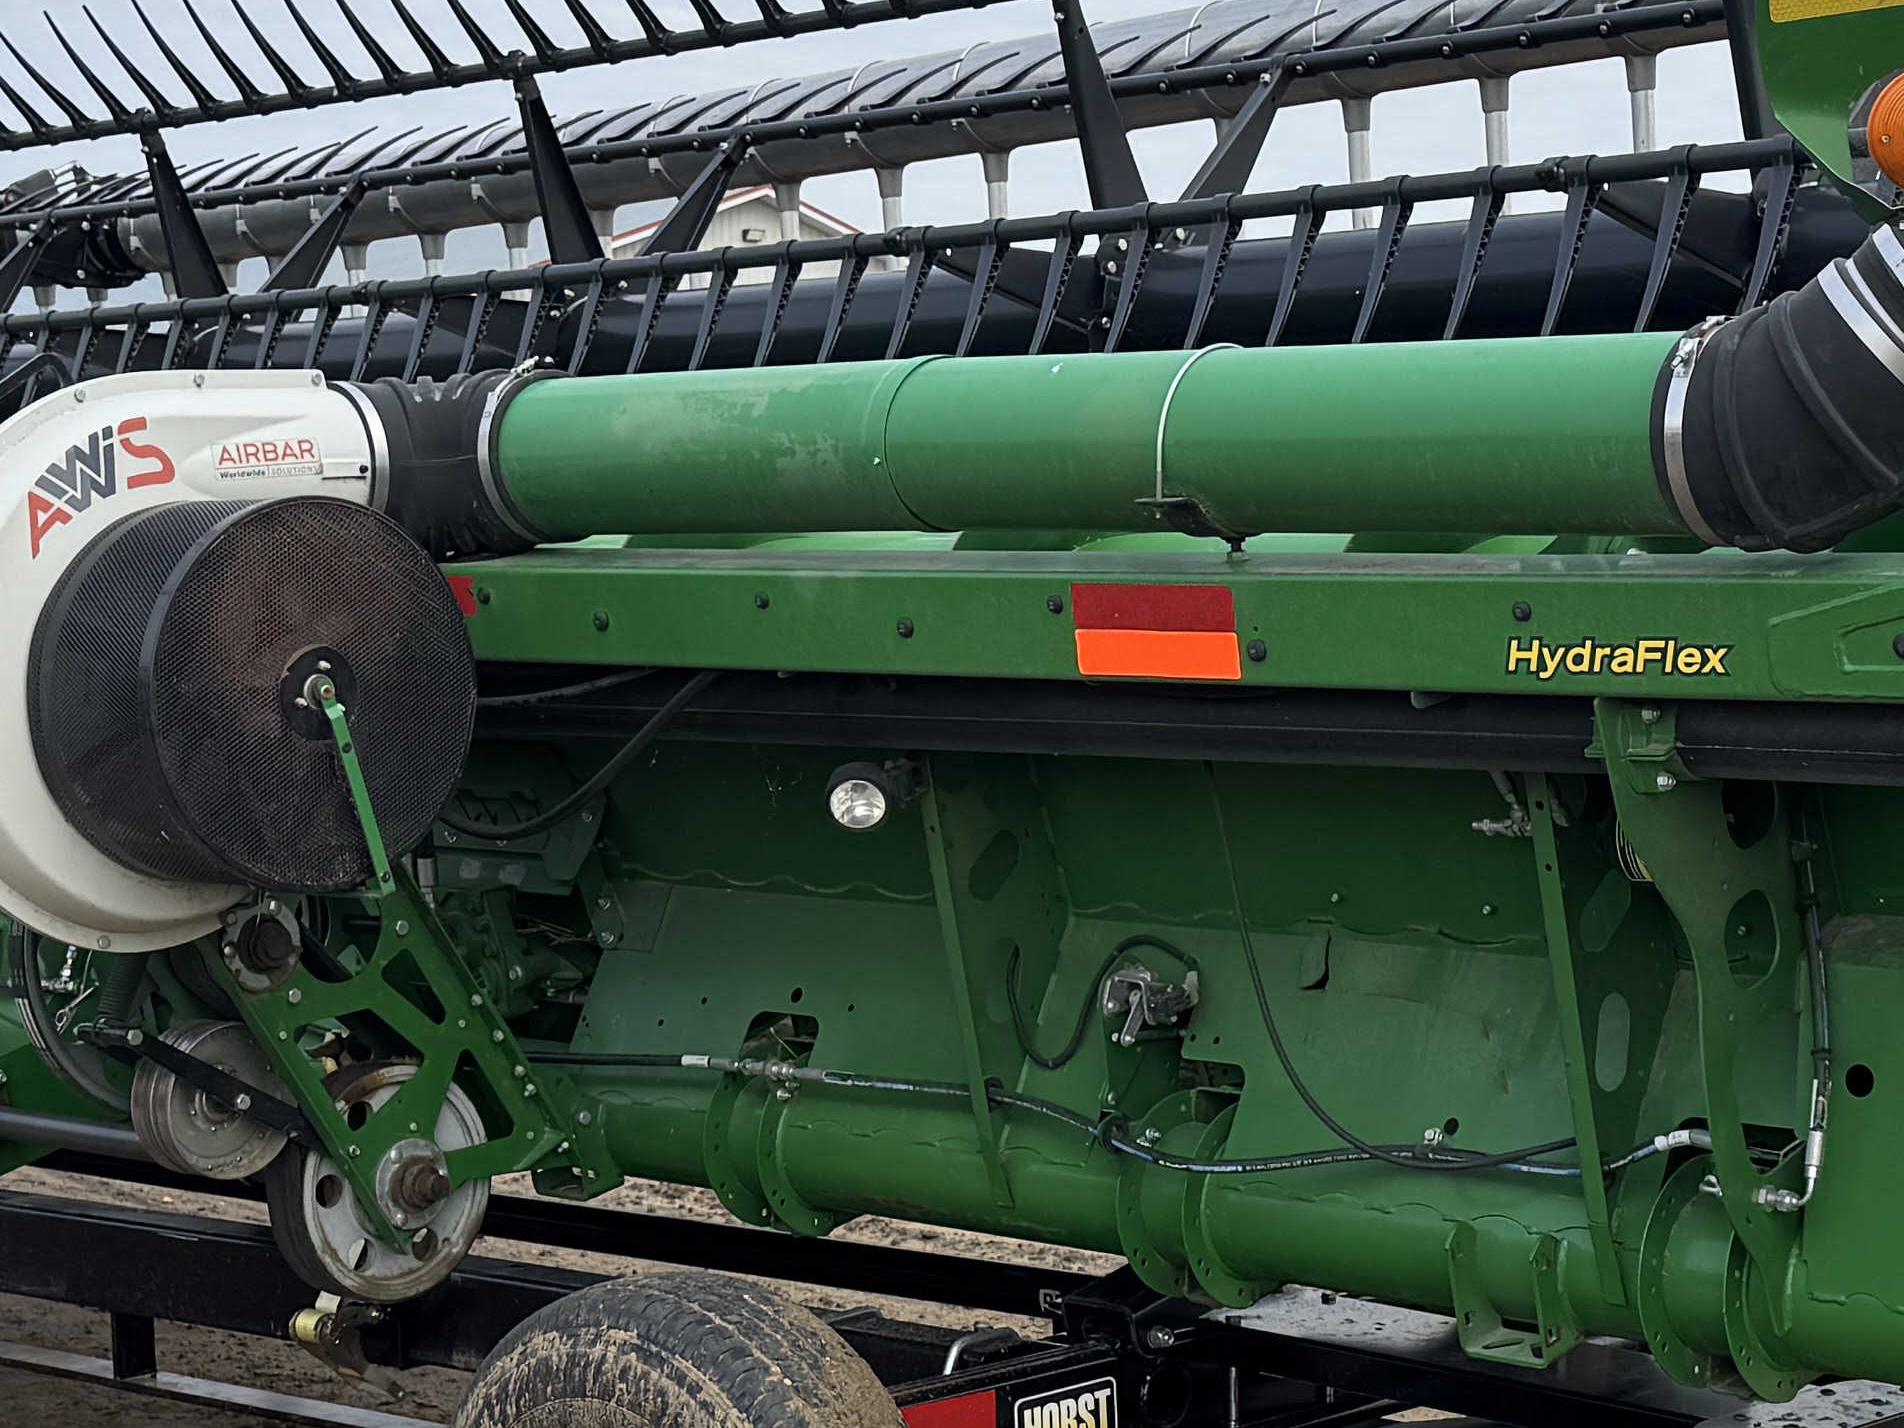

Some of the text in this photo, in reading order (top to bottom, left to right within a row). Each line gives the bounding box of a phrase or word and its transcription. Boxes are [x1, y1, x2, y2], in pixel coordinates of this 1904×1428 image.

[218, 439, 316, 466] AIRBAR
[219, 469, 267, 480] Worldwide
[1507, 639, 1729, 681] HydraFlex
